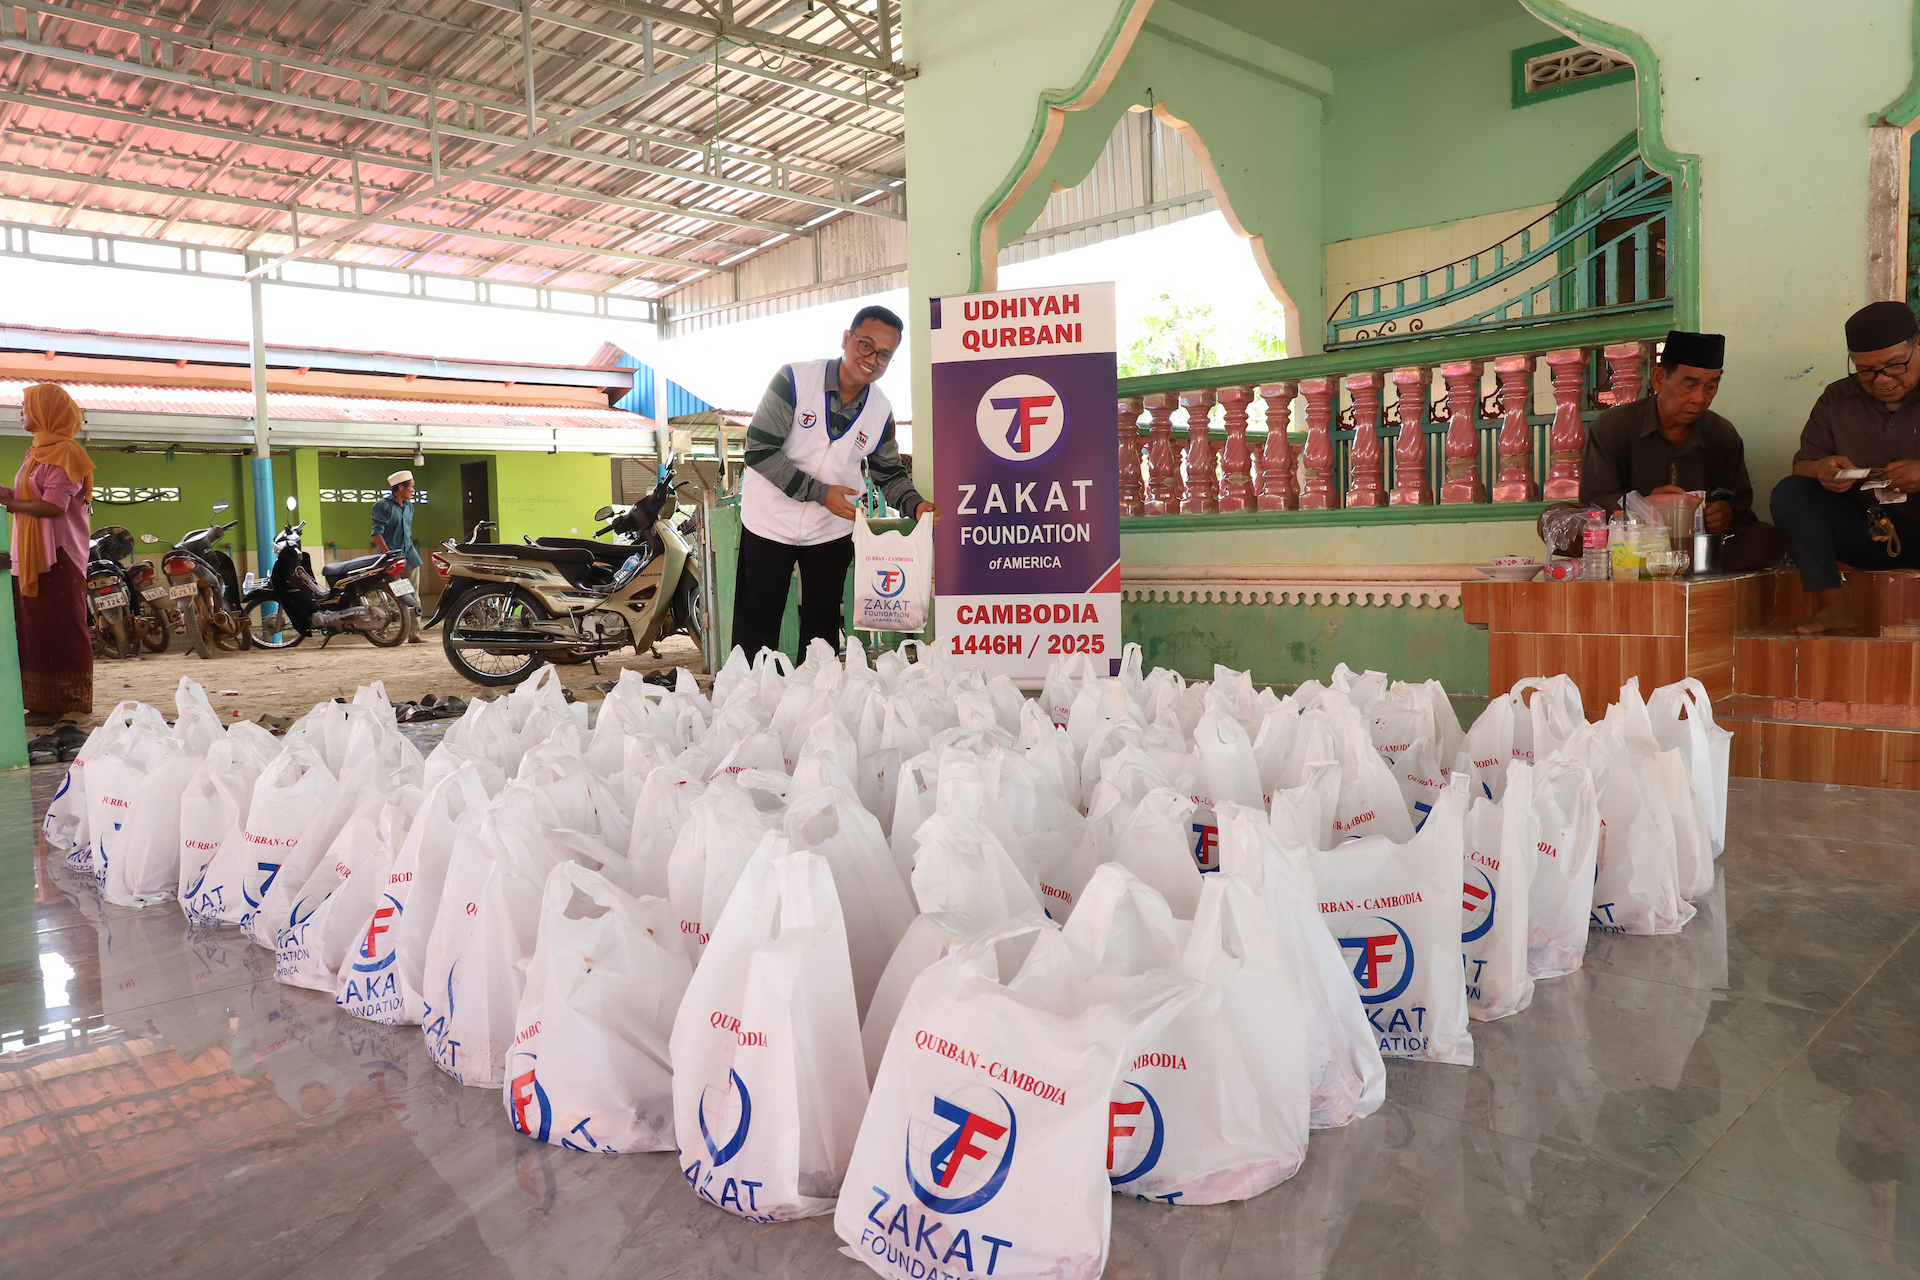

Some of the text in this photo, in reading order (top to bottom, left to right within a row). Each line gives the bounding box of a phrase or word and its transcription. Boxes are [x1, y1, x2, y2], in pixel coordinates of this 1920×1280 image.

[964, 294, 1079, 321] UDHIYAH
[962, 323, 1082, 352] QURBANI
[957, 480, 1093, 515] ZAKAT
[960, 523, 1090, 546] FOUNDATION
[989, 556, 1062, 570] of AMERICA
[864, 599, 910, 611] ZAKAT
[957, 603, 1099, 625] CAMBODIA
[951, 634, 1022, 655] 1446H
[1048, 633, 1105, 655] 2025
[245, 832, 281, 847] QURBAN
[1364, 892, 1423, 911] CAMBODIA
[1365, 1007, 1426, 1033] KAT
[915, 1030, 980, 1069] QURBAN
[989, 1061, 1067, 1106] CAMBODIA
[1130, 1052, 1188, 1072] MBODIA
[868, 1185, 1013, 1276] ZAKAT
